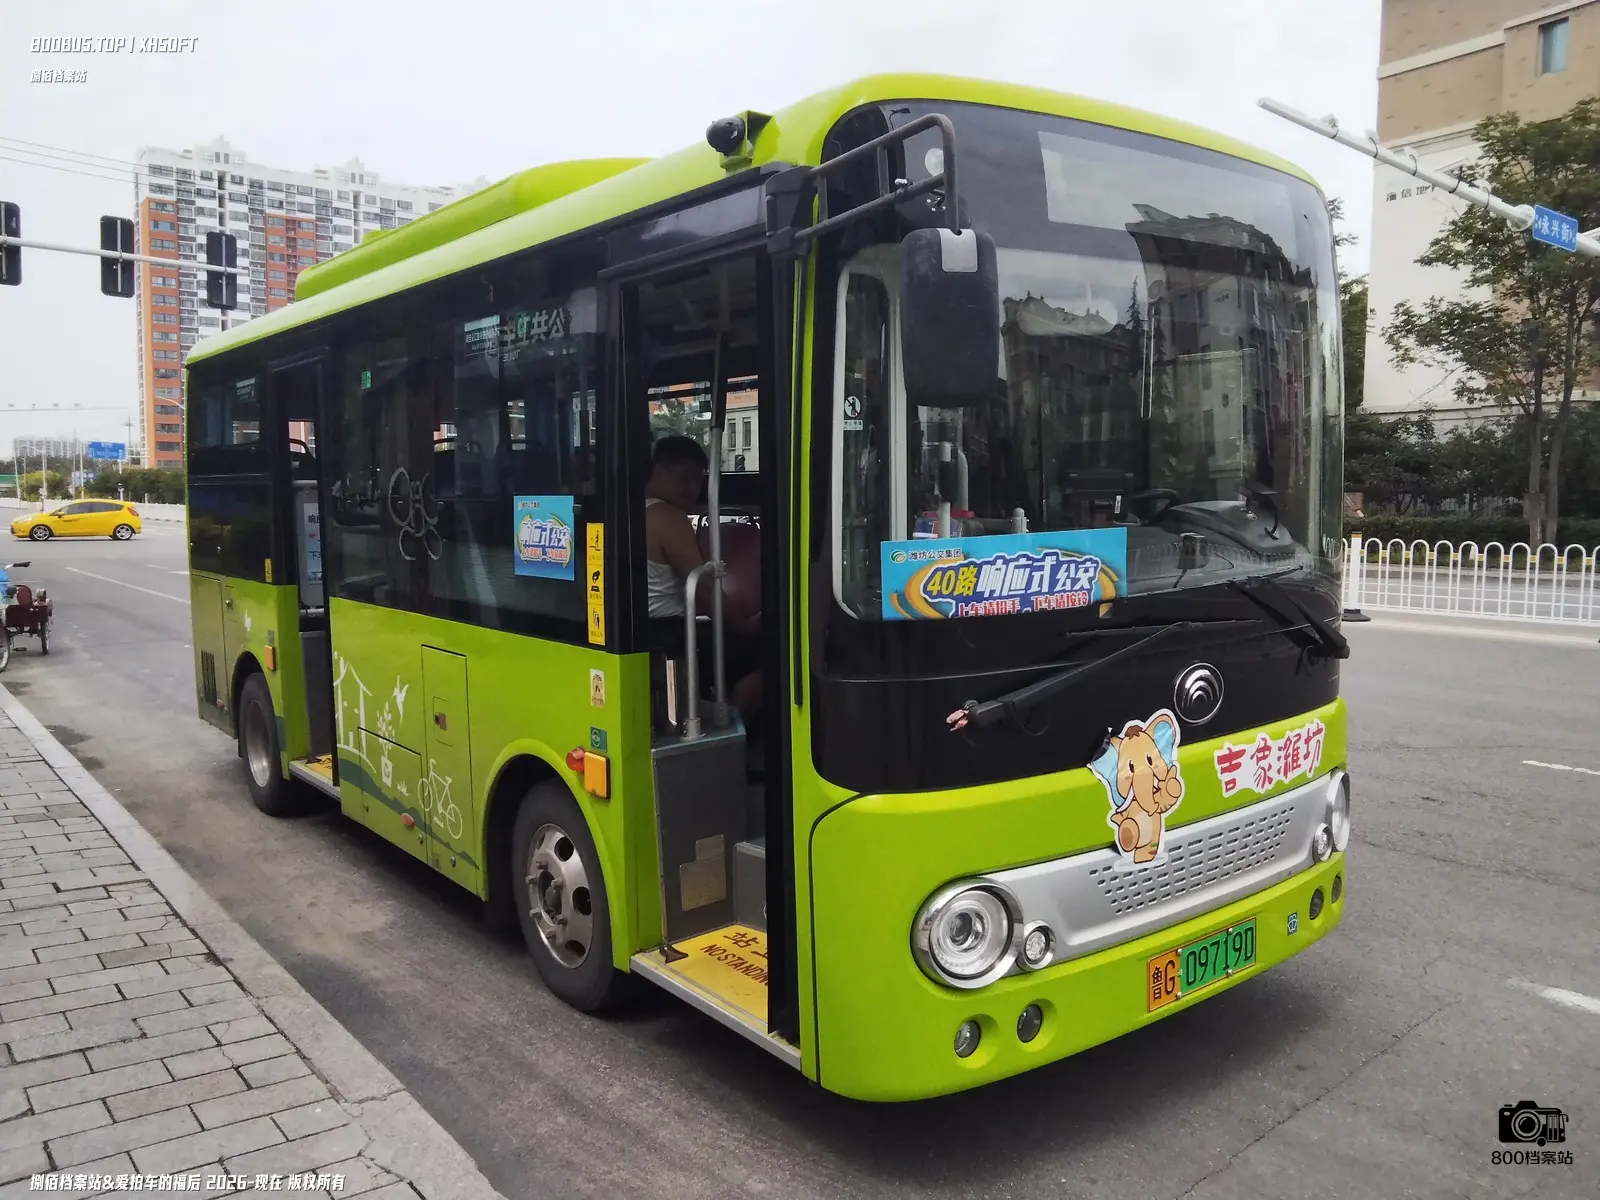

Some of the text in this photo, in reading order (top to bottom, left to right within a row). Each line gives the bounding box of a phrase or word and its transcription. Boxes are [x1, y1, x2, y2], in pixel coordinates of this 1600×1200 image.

[1385, 183, 1436, 202] 海信地
[909, 548, 962, 561] 潍坊公交集团
[717, 953, 768, 986] STANDIN
